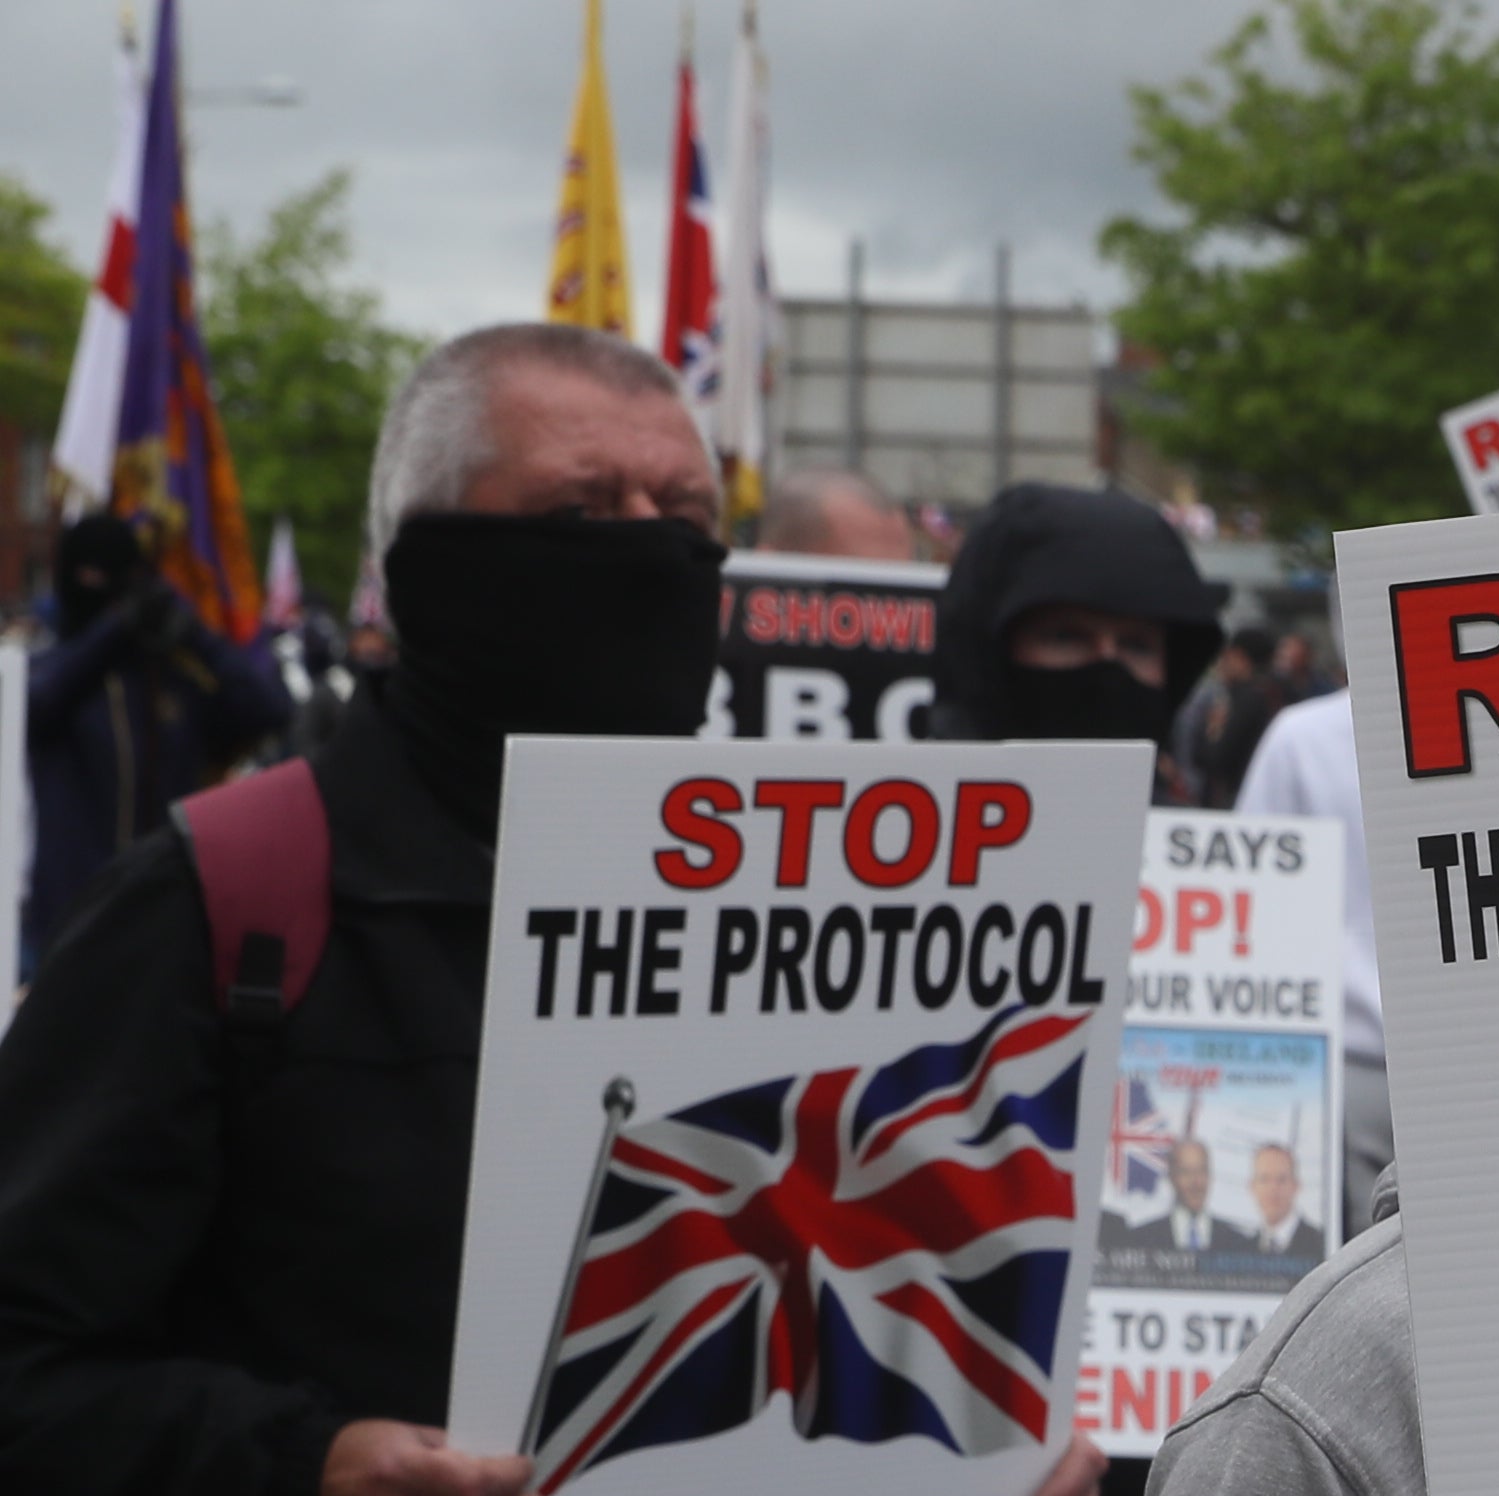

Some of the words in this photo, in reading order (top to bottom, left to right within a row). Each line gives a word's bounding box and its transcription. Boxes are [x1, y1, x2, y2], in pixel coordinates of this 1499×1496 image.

[744, 586, 936, 654] SHOWI
[654, 778, 1034, 889] STOP
[1167, 826, 1305, 873] SAYS
[526, 908, 688, 1020] THE
[709, 902, 1106, 1015] PROTOCOL
[1206, 975, 1321, 1018] VOICE
[1112, 1312, 1167, 1350] TO
[1184, 1313, 1260, 1353] STA
